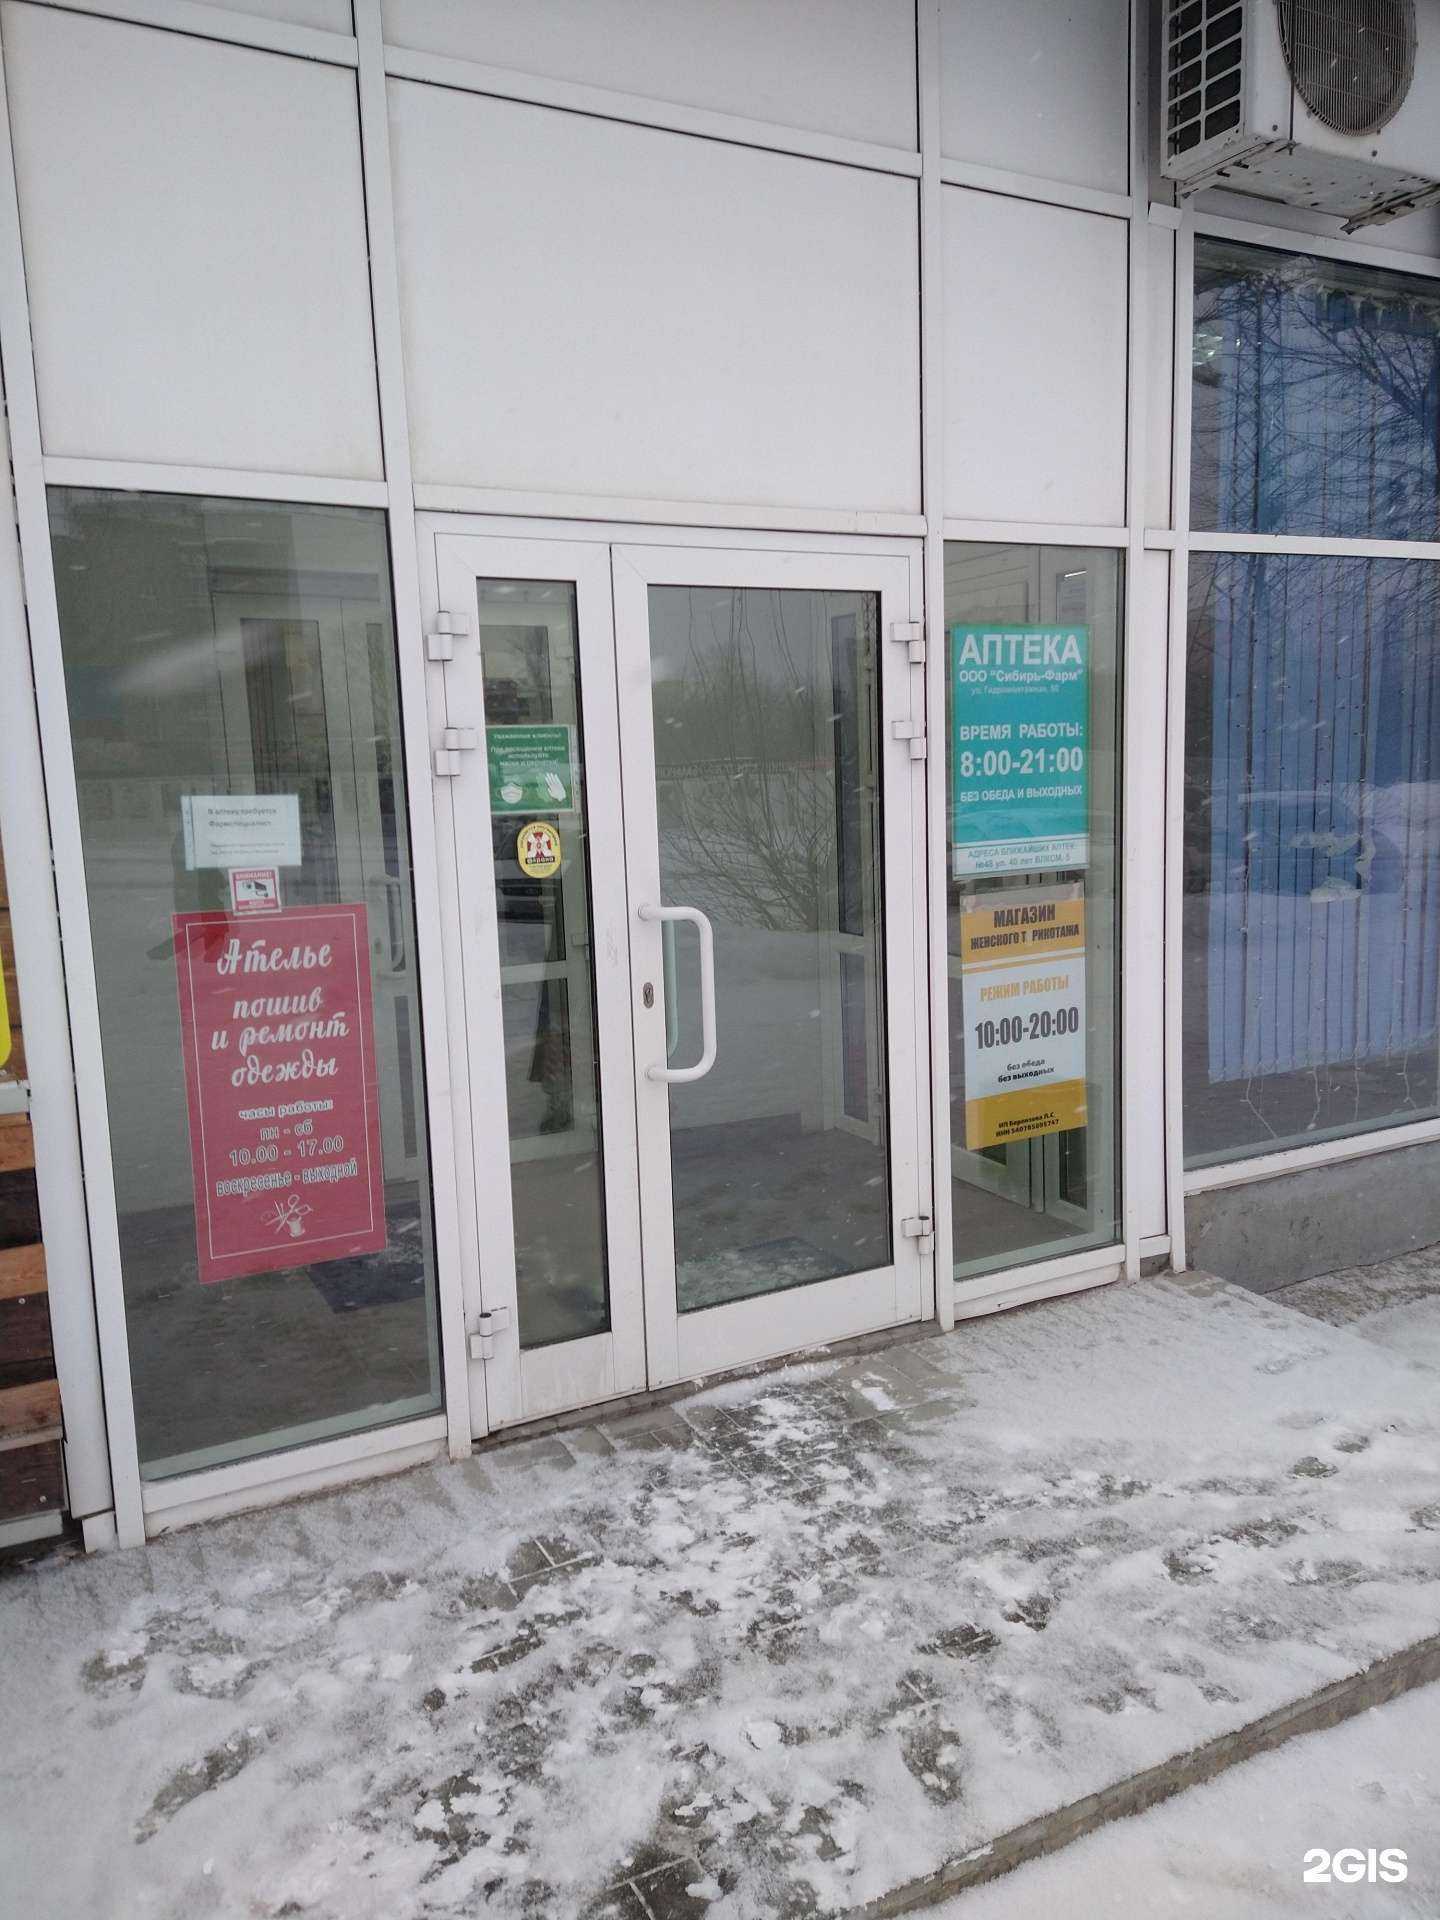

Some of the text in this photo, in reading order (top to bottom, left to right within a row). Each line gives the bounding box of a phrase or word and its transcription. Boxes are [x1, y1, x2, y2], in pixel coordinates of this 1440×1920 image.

[959, 634, 1082, 665] АПТЕКА
[960, 668, 1083, 683] ООО "Сибирь-Фарм"
[959, 722, 1083, 741] ВРЕМЯ РАБОТЫ:
[960, 746, 1083, 777] 8:00-21:00
[960, 785, 1082, 802] БЕЗ ОБЕДА И ВЫХОДНЫХ
[993, 904, 1055, 928] МАГАЗИН
[970, 932, 1019, 950] ЖЕНСКОГО
[216, 938, 333, 975] Ателье
[981, 974, 1069, 1001] РЕЖИМ РАБОТЫ
[233, 986, 324, 1020] пошив
[211, 1011, 350, 1057] и ремонт
[975, 1006, 1079, 1049] 10:00-20:00
[231, 1049, 338, 1087] одежды
[998, 1067, 1055, 1083] без выходных
[1006, 1063, 1020, 1072] без
[238, 1099, 333, 1120] часы работы
[294, 1119, 313, 1137] сб
[229, 1144, 278, 1166] 10.00
[298, 1135, 344, 1157] 17.00
